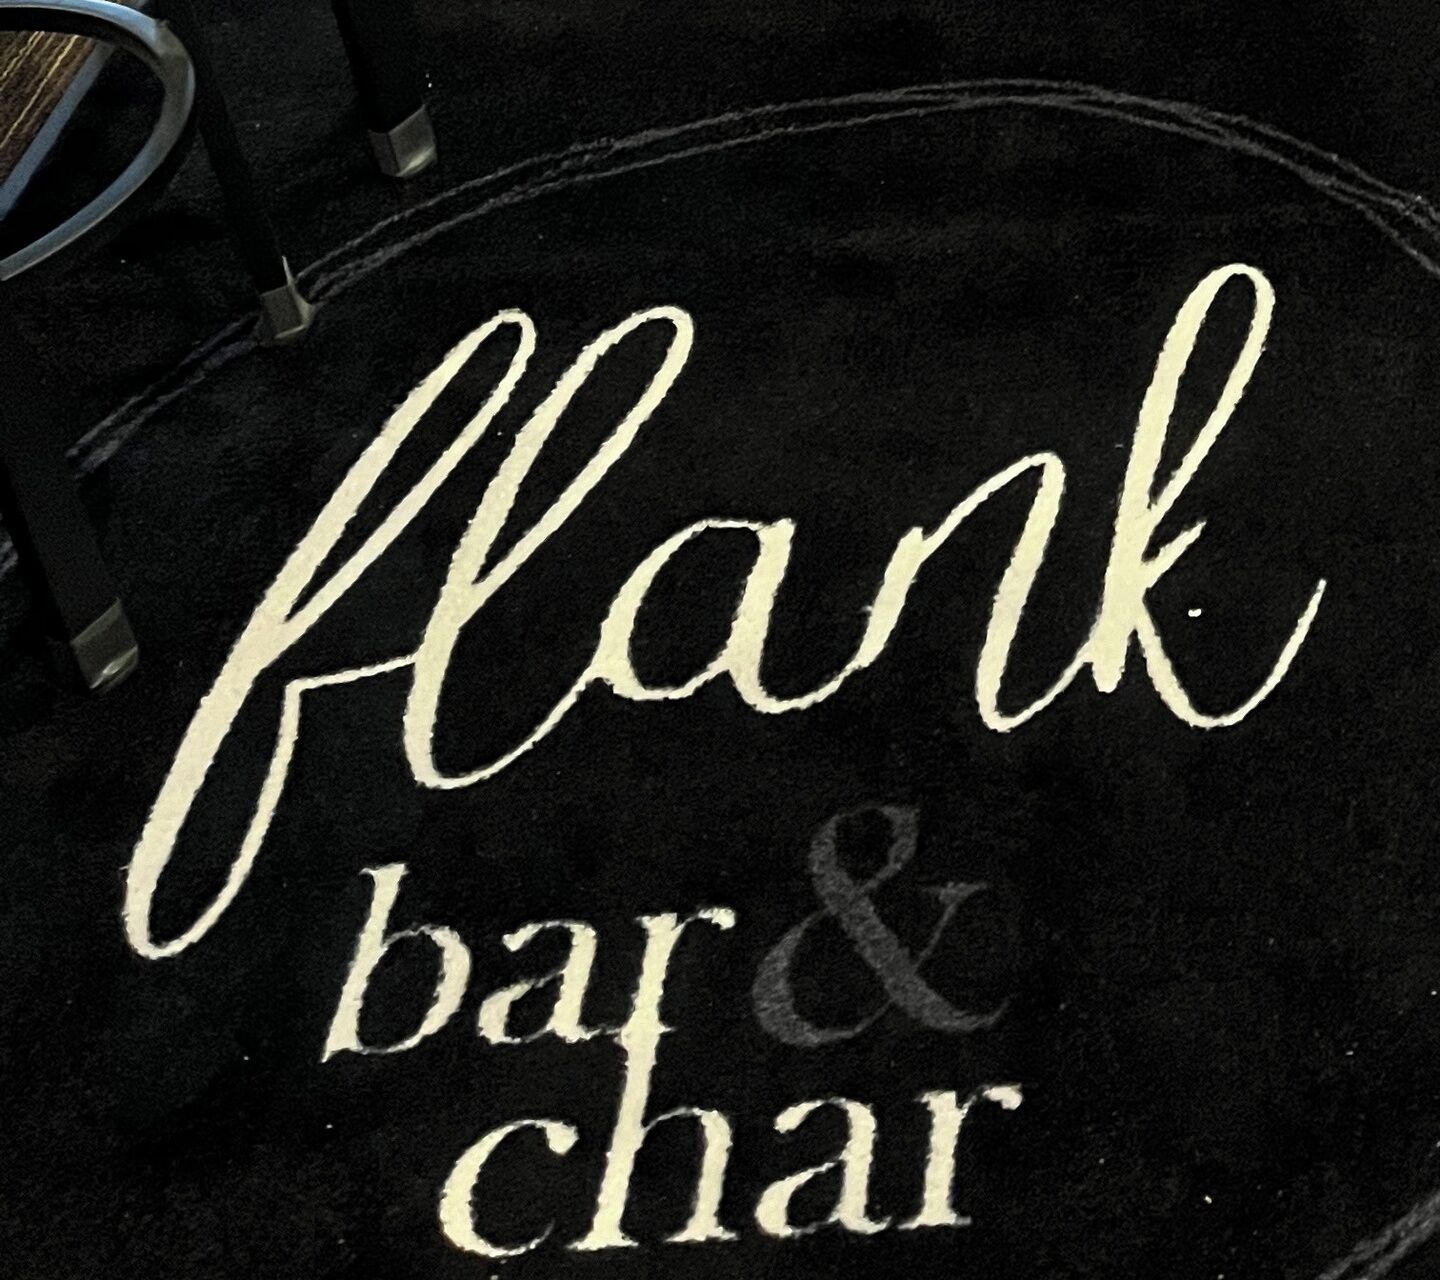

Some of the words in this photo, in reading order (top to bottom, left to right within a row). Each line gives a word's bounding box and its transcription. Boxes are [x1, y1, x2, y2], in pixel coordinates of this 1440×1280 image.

[124, 264, 1327, 960] flank
[322, 863, 737, 1064] bar
[751, 804, 1003, 1046] &
[436, 1055, 1024, 1258] char
